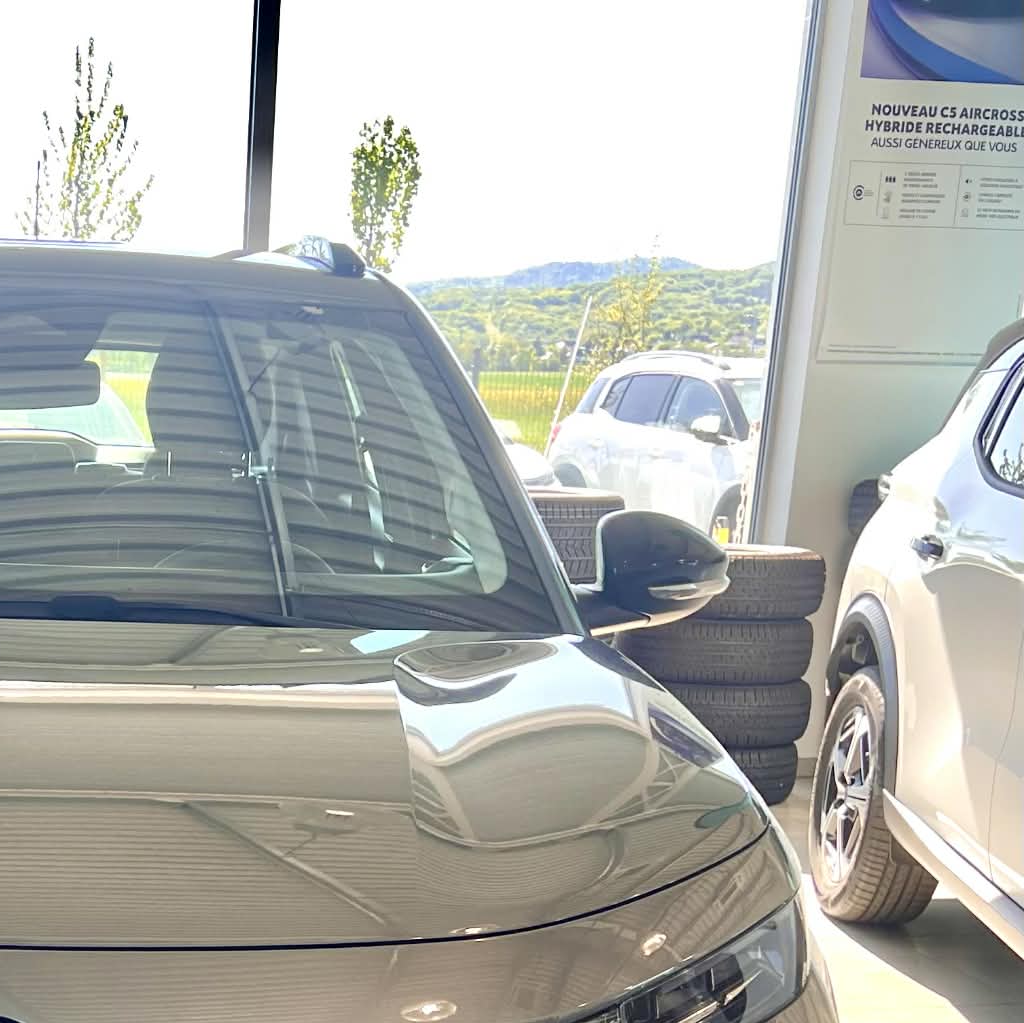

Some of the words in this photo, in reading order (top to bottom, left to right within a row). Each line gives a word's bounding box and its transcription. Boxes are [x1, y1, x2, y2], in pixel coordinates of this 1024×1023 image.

[871, 103, 938, 118] NOUVEAU
[940, 106, 957, 119] C5
[959, 107, 1024, 122] AIRCROSS
[864, 119, 923, 134] HYBRIDE
[871, 137, 903, 148] AUSSI
[964, 140, 986, 151] QUE
[988, 141, 1017, 153] VOUS
